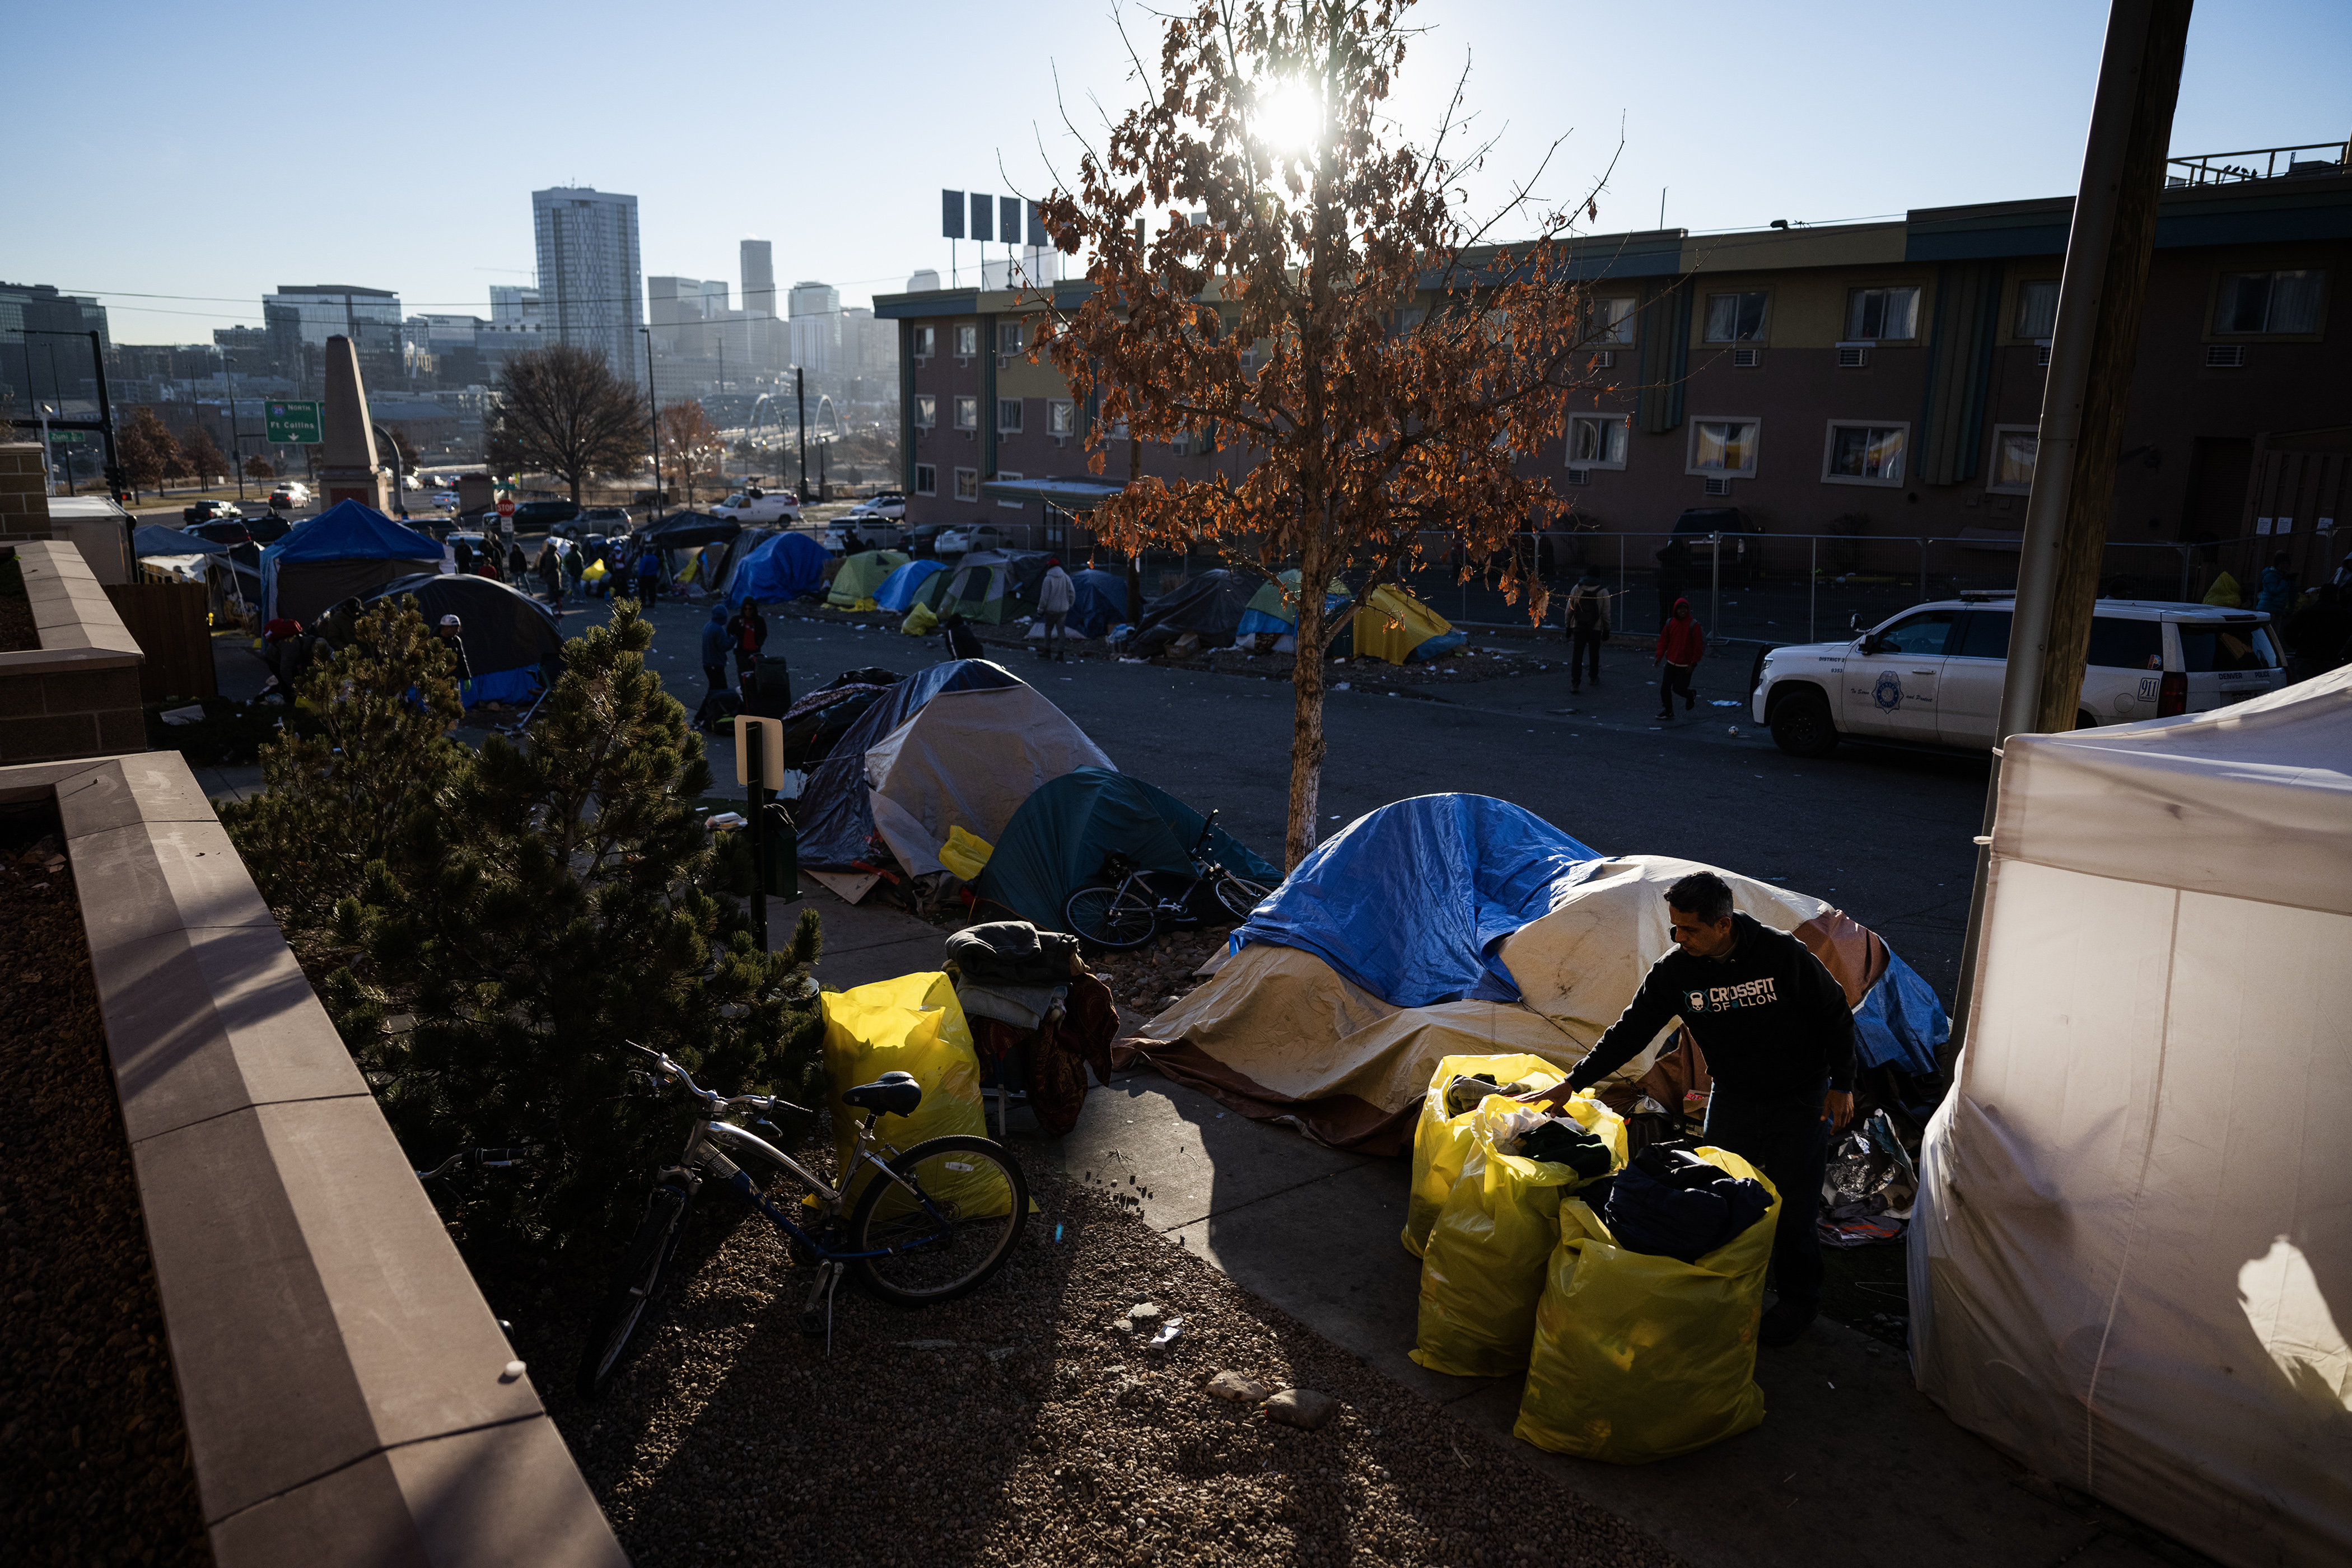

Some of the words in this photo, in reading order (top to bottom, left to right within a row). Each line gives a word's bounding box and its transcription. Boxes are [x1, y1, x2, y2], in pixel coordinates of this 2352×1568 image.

[1879, 683, 1897, 692] DENVER
[2140, 679, 2157, 697] 911
[1710, 977, 1774, 1002] CROSSFIT
